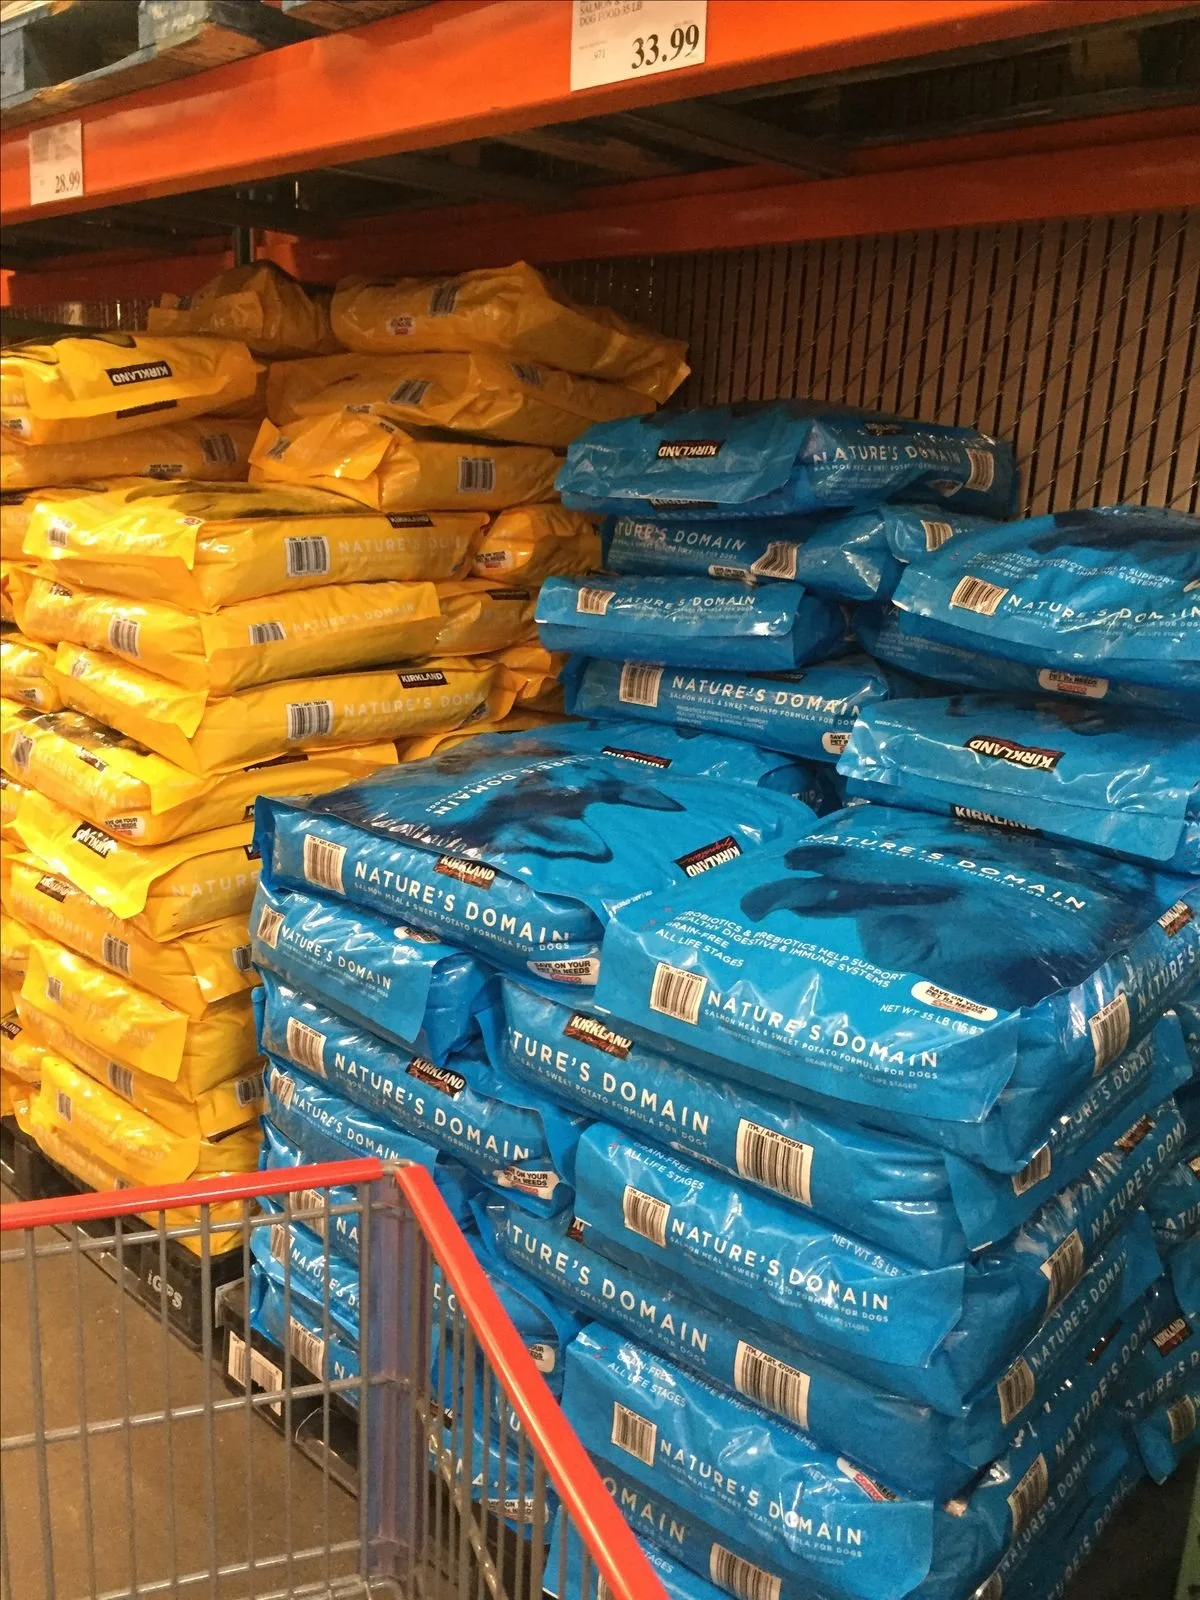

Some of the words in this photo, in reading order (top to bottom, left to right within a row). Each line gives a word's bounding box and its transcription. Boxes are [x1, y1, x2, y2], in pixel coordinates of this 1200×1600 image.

[631, 24, 699, 69] 33.99
[54, 170, 80, 193] 28.99
[112, 361, 169, 385] KIRKLAND
[658, 445, 719, 458] KIRKLAND
[813, 445, 898, 464] NATURE'S
[904, 446, 962, 464] DOMAIN
[339, 539, 420, 553] NATURE'S
[674, 529, 746, 551] DOMAIN
[1129, 568, 1176, 586] SUPPORT
[614, 596, 685, 610] NATURE'S
[692, 596, 756, 606] DOMAIN
[1008, 596, 1107, 618] NATURE'S
[293, 613, 360, 633] NATURE'S
[400, 672, 443, 683] KIRKLAND
[672, 675, 766, 702] NATURE'S
[344, 698, 432, 717] NATURE'S
[670, 693, 696, 702] SALMON
[698, 697, 716, 705] MEAL
[724, 702, 747, 711] SWEET
[749, 706, 778, 715] POTATO
[780, 710, 815, 722] FORMULA
[818, 717, 833, 725] FOR
[969, 738, 1054, 768] KIRKLAND
[433, 774, 518, 816] DOMAIN
[440, 856, 496, 880] KIRKLAND
[686, 846, 741, 878] KIRKLAND
[805, 834, 944, 861] NATURE'S
[957, 860, 1086, 910] DOMAIN
[354, 860, 455, 912] NATURE'S
[465, 901, 570, 944] DOMAIN
[385, 892, 404, 905] MEAL
[412, 902, 437, 919] SWEET
[440, 914, 470, 930] POTATO
[473, 926, 512, 946] FORMULA
[516, 941, 534, 952] FOR
[539, 942, 569, 951] DOGS
[665, 921, 729, 949] GRAIN-FREE
[281, 925, 333, 962] NATURE'S
[338, 956, 391, 990] DOMAIN
[656, 928, 676, 942] ALL
[678, 937, 701, 949] LIFE
[702, 945, 744, 967] STAGES
[674, 916, 720, 932] HEALTHY
[722, 928, 776, 950] DIGESTIVE
[789, 948, 835, 968] IMMUNE
[838, 961, 891, 988] SYSTEMS
[683, 911, 742, 933] PROBIOTICS
[753, 931, 816, 952] PREBIOTICS
[818, 947, 850, 962] HELP
[852, 958, 906, 980] SUPPORT
[567, 960, 590, 968] YOUR
[1136, 944, 1196, 1010] NATURE'S
[880, 1003, 900, 1014] NET
[902, 1007, 919, 1017] WT
[920, 1012, 934, 1021] 35
[936, 1016, 950, 1026] LB
[925, 989, 941, 1000] PET
[955, 1000, 983, 1015] NEEDS
[929, 985, 950, 997] SAVE
[950, 994, 964, 1003] ON
[965, 1001, 988, 1012] YOUR
[571, 1015, 632, 1049] KIRKLAND
[705, 1009, 735, 1024] SALMON
[738, 1019, 760, 1033] MEAL
[771, 1032, 798, 1047] SWEET
[802, 1042, 837, 1057] POTATO
[839, 1053, 879, 1072] FORMULA
[883, 1067, 904, 1077] FOR
[908, 1071, 938, 1080] DOGS
[707, 990, 823, 1041] NATURE'S
[833, 1030, 938, 1068] DOMAIN
[411, 1057, 465, 1090] KIRKLAND
[508, 1027, 590, 1082] TURE'S
[603, 1072, 709, 1135] DOMAIN
[334, 1053, 425, 1116] NATURE'S
[434, 1108, 529, 1161] DOMAIN
[575, 1084, 608, 1104] POTATO
[612, 1100, 655, 1124] FORMULA
[658, 1121, 677, 1134] FOR
[681, 1131, 707, 1147] DOGS
[292, 1093, 343, 1134] NATURE'S
[347, 1128, 399, 1160] DOMAIN
[765, 1131, 778, 1142] ART.
[624, 1148, 641, 1161] ALL
[643, 1157, 664, 1173] LIFE
[666, 1170, 705, 1190] STAGES
[633, 1142, 693, 1173] GRAIN-FREE
[526, 1172, 548, 1181] YOUR
[1091, 1156, 1154, 1236] NATURE'S
[671, 1218, 781, 1277] NATURE'S
[789, 1268, 889, 1310] DOMAIN
[832, 1233, 851, 1250] NET
[853, 1245, 871, 1260] WT
[884, 1264, 898, 1276] LB
[701, 1251, 723, 1265] MEAL
[732, 1265, 760, 1281] SWEET
[763, 1277, 793, 1295] POTATO
[796, 1290, 839, 1311] FORMULA
[841, 1307, 858, 1317] FOR
[862, 1312, 889, 1323] DOGS
[575, 1286, 608, 1308] POTATO
[611, 1303, 655, 1334] FORMULA
[658, 1332, 676, 1346] FOR
[601, 1278, 709, 1353] DOMAIN
[1031, 1300, 1089, 1368] NATURE'S
[1152, 1318, 1187, 1348] KIRKLAND
[607, 1363, 626, 1378] ALL
[649, 1384, 686, 1408] STAGES
[1055, 1361, 1119, 1458] NATURE'S
[808, 1468, 826, 1482] NET
[855, 1473, 884, 1501] COSTCO
[660, 1439, 760, 1508] NATURE'S
[768, 1501, 862, 1546] DOMAIN
[1001, 1498, 1057, 1573] NATURE'S
[1057, 1443, 1096, 1499] DOMAIN
[814, 1542, 832, 1552] FOR
[837, 1548, 862, 1558] DOGS
